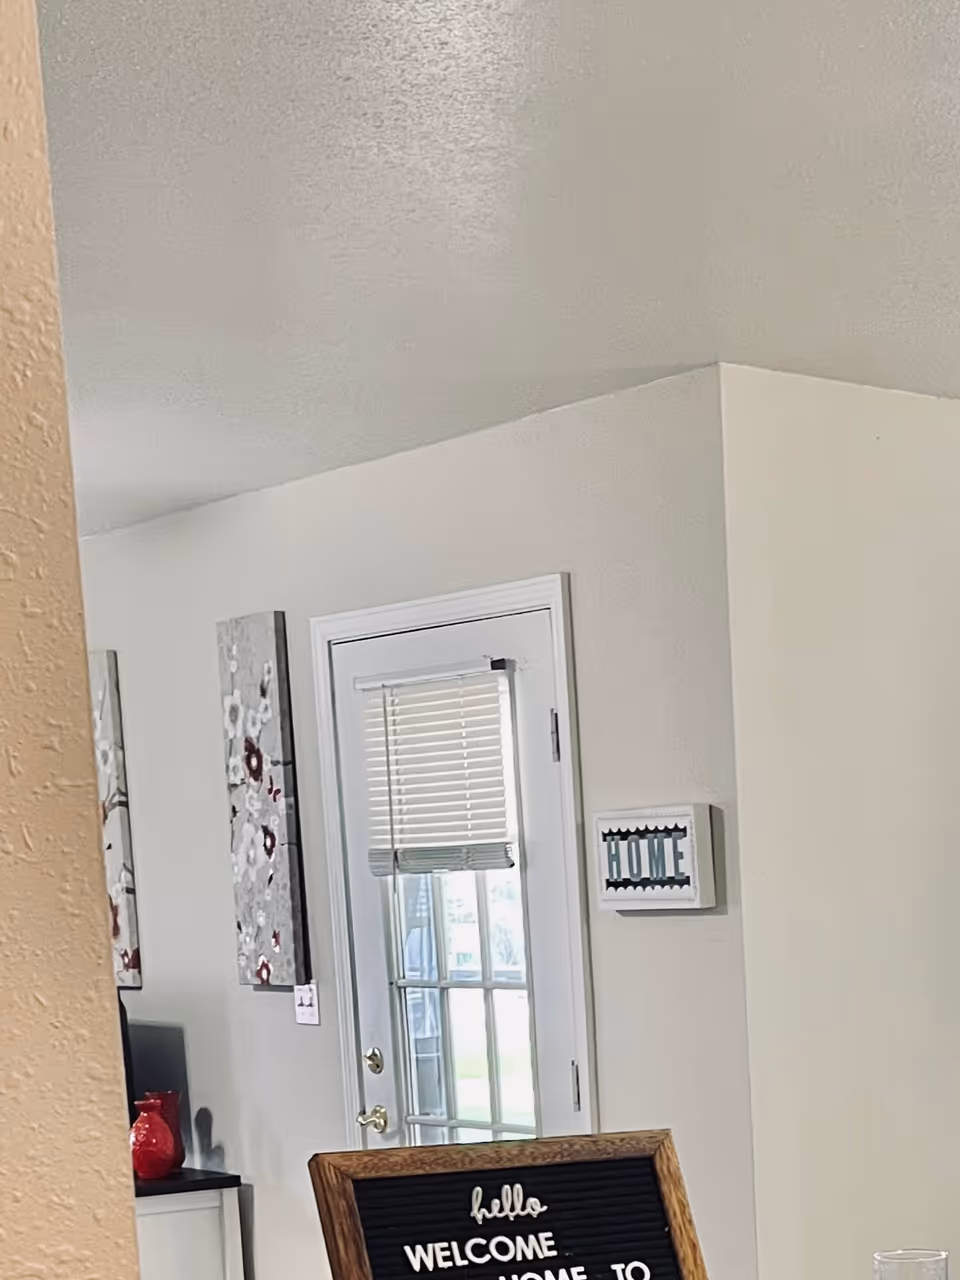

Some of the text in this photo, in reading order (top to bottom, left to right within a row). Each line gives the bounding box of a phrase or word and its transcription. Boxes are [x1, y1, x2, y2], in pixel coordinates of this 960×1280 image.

[606, 832, 686, 881] HOME
[471, 1183, 548, 1225] hello
[404, 1232, 558, 1272] WELCOME
